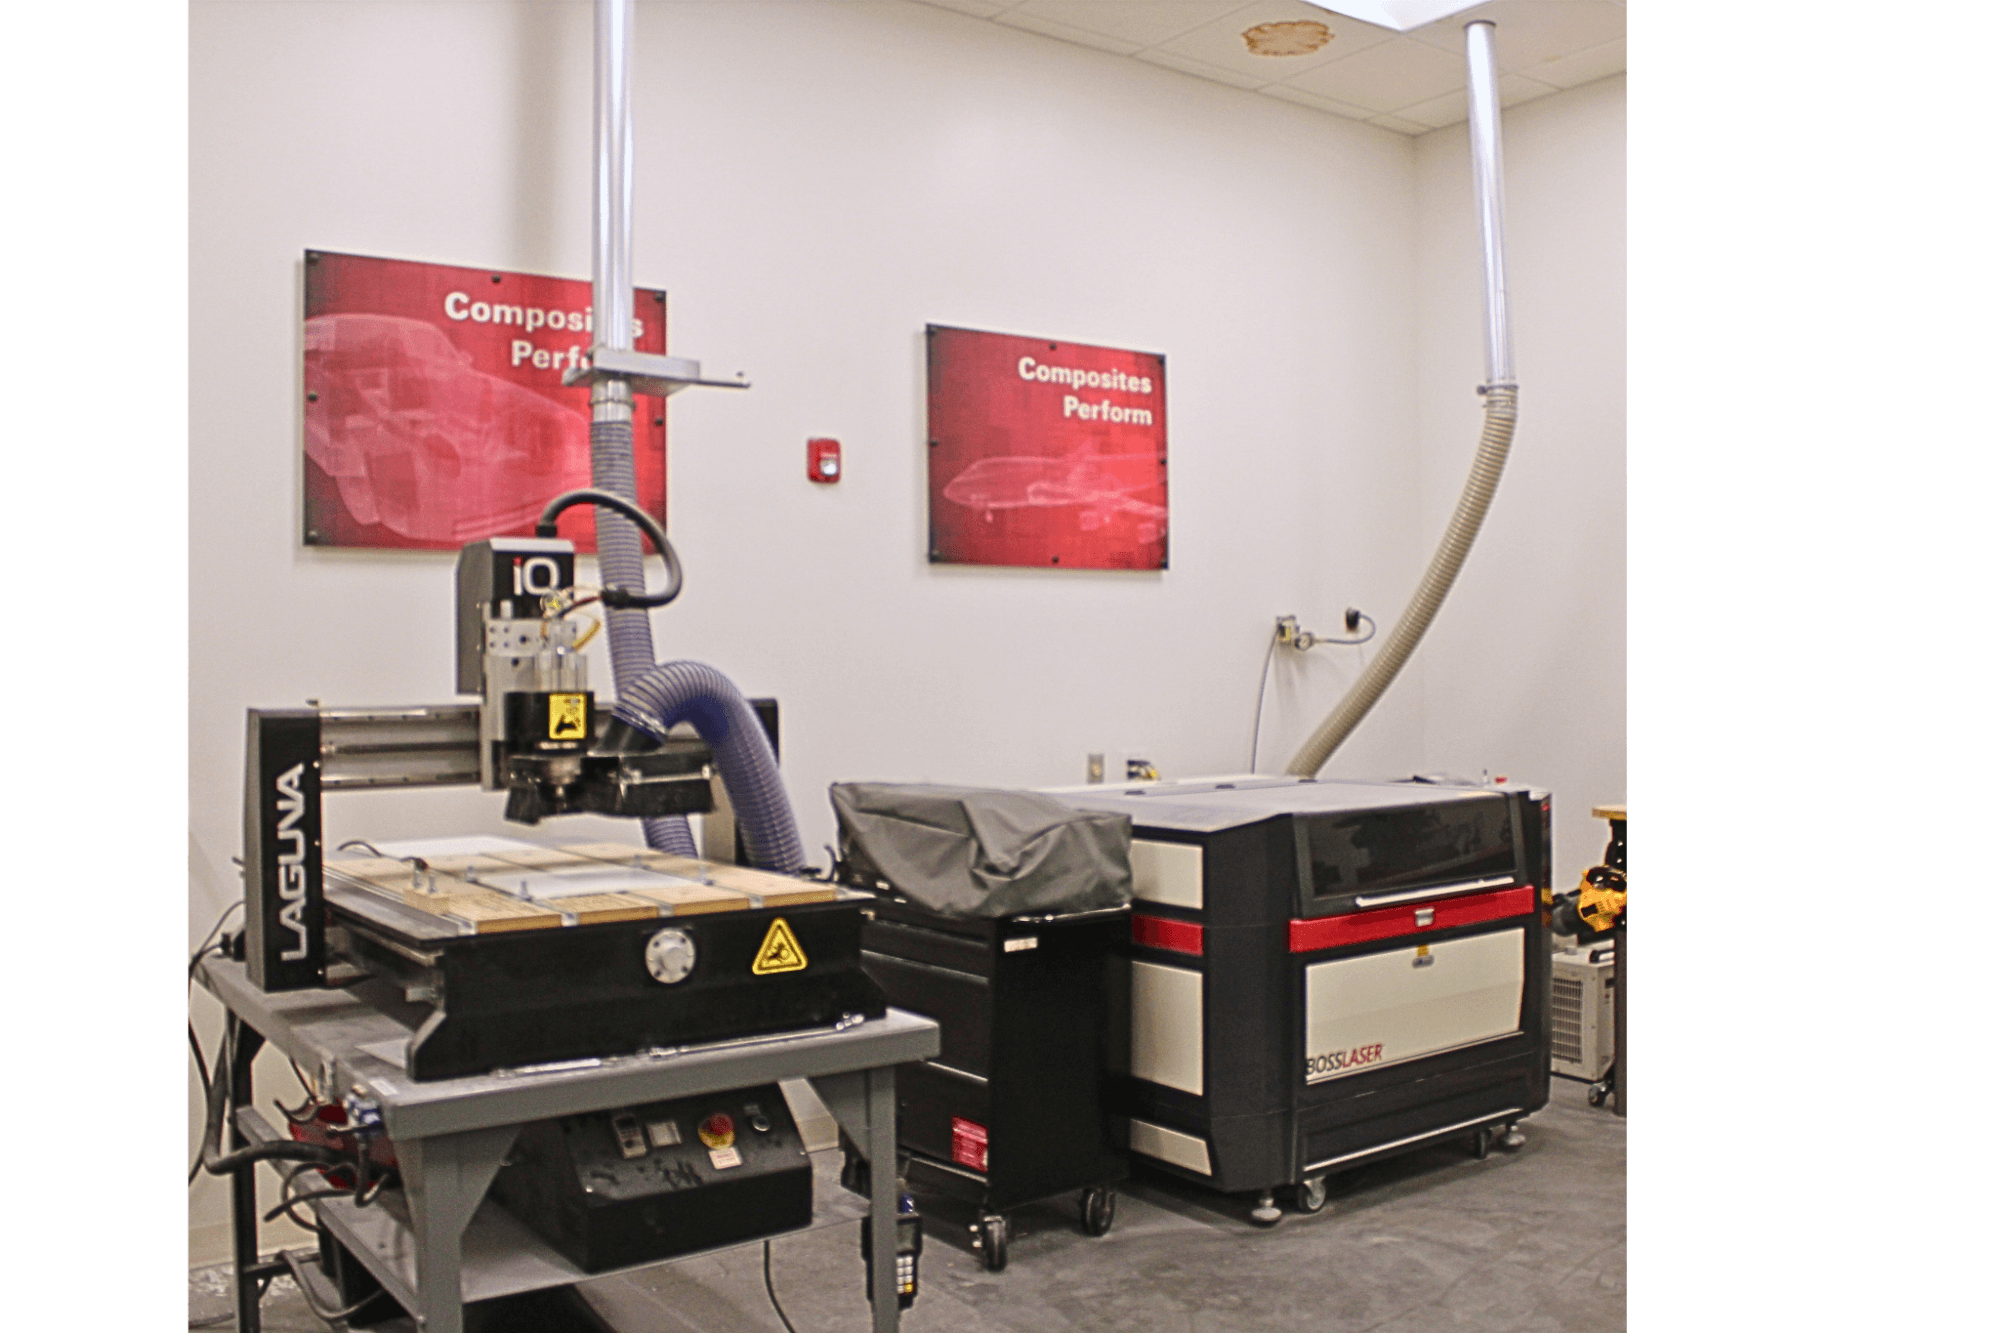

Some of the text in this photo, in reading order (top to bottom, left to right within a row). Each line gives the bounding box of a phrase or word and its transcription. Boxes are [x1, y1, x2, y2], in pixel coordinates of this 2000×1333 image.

[445, 291, 644, 338] Composis
[512, 340, 591, 370] Perf
[1018, 356, 1152, 394] Composites
[1063, 395, 1152, 426] Perform
[277, 762, 307, 961] LAGUNA
